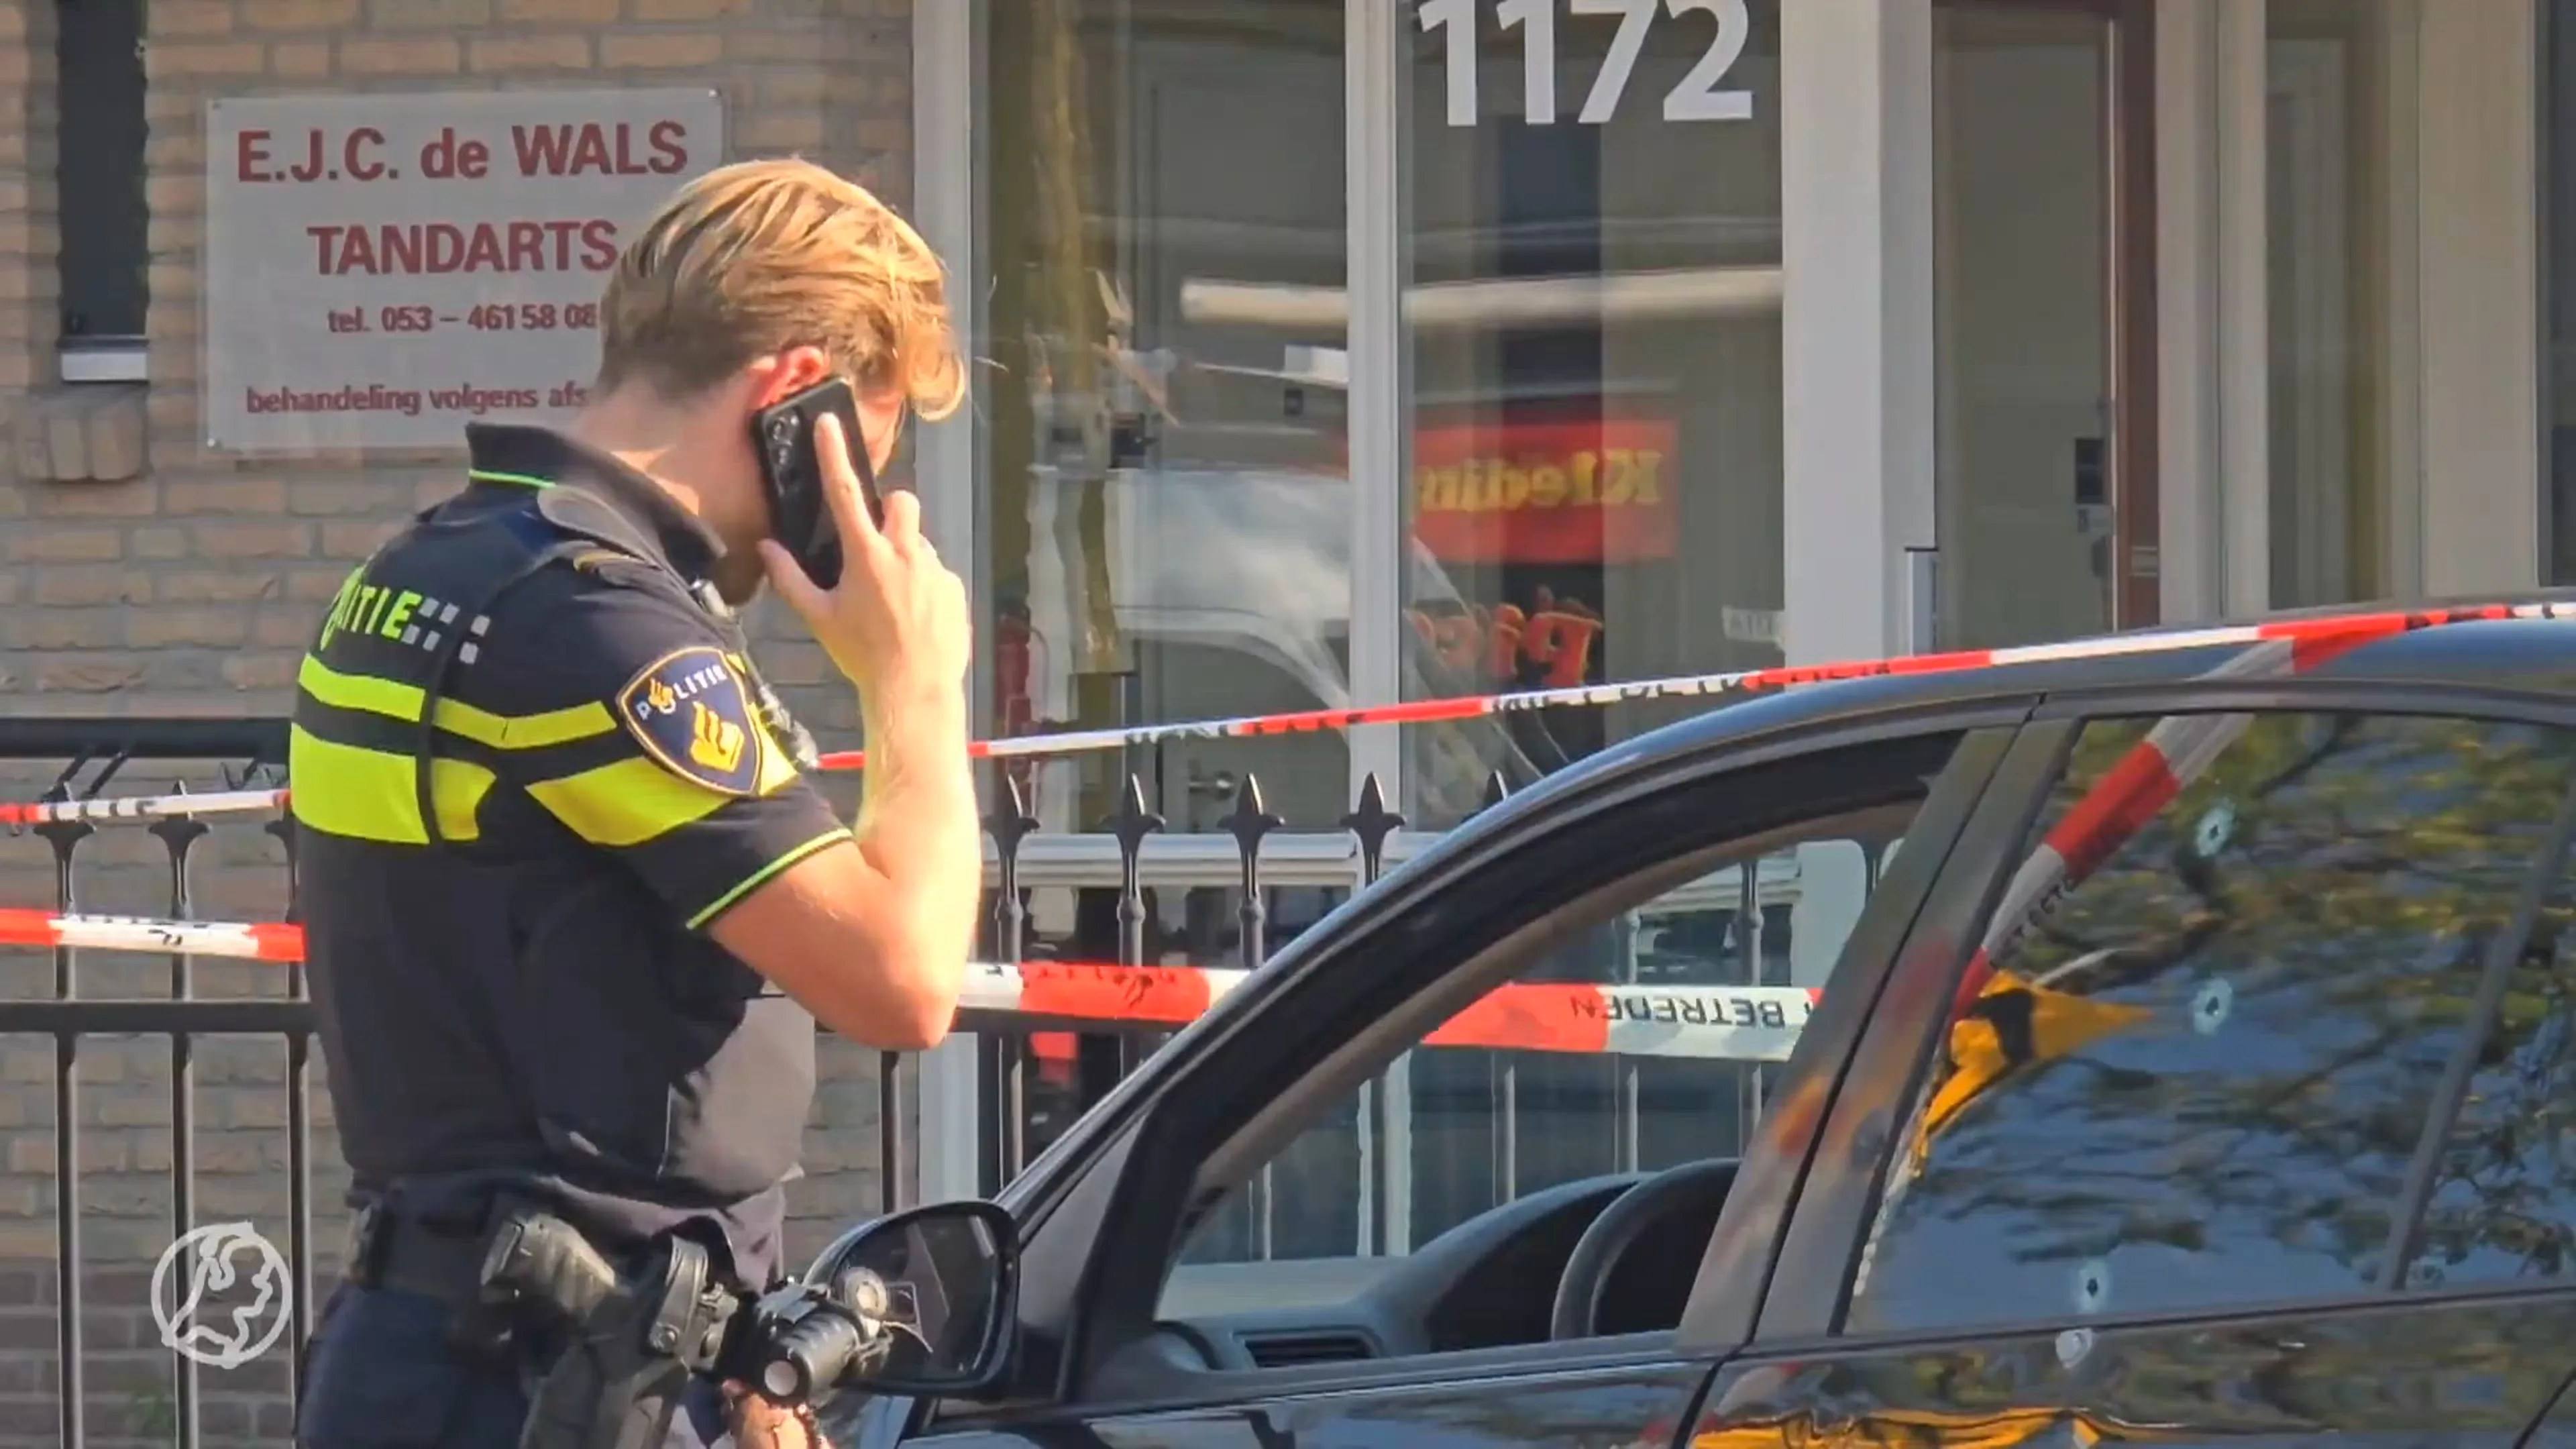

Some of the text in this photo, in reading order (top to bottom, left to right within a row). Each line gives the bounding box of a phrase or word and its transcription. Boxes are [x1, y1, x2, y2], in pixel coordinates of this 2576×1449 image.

[1419, 0, 1753, 125] 1172
[238, 120, 688, 182] E.J.C. de WALS
[307, 220, 618, 275] TANDARTS
[328, 306, 372, 333] tel.
[381, 306, 433, 331] 053
[247, 384, 422, 417] behandeling
[429, 382, 539, 415] volgens
[1570, 995, 1786, 1028] BETREDEN
